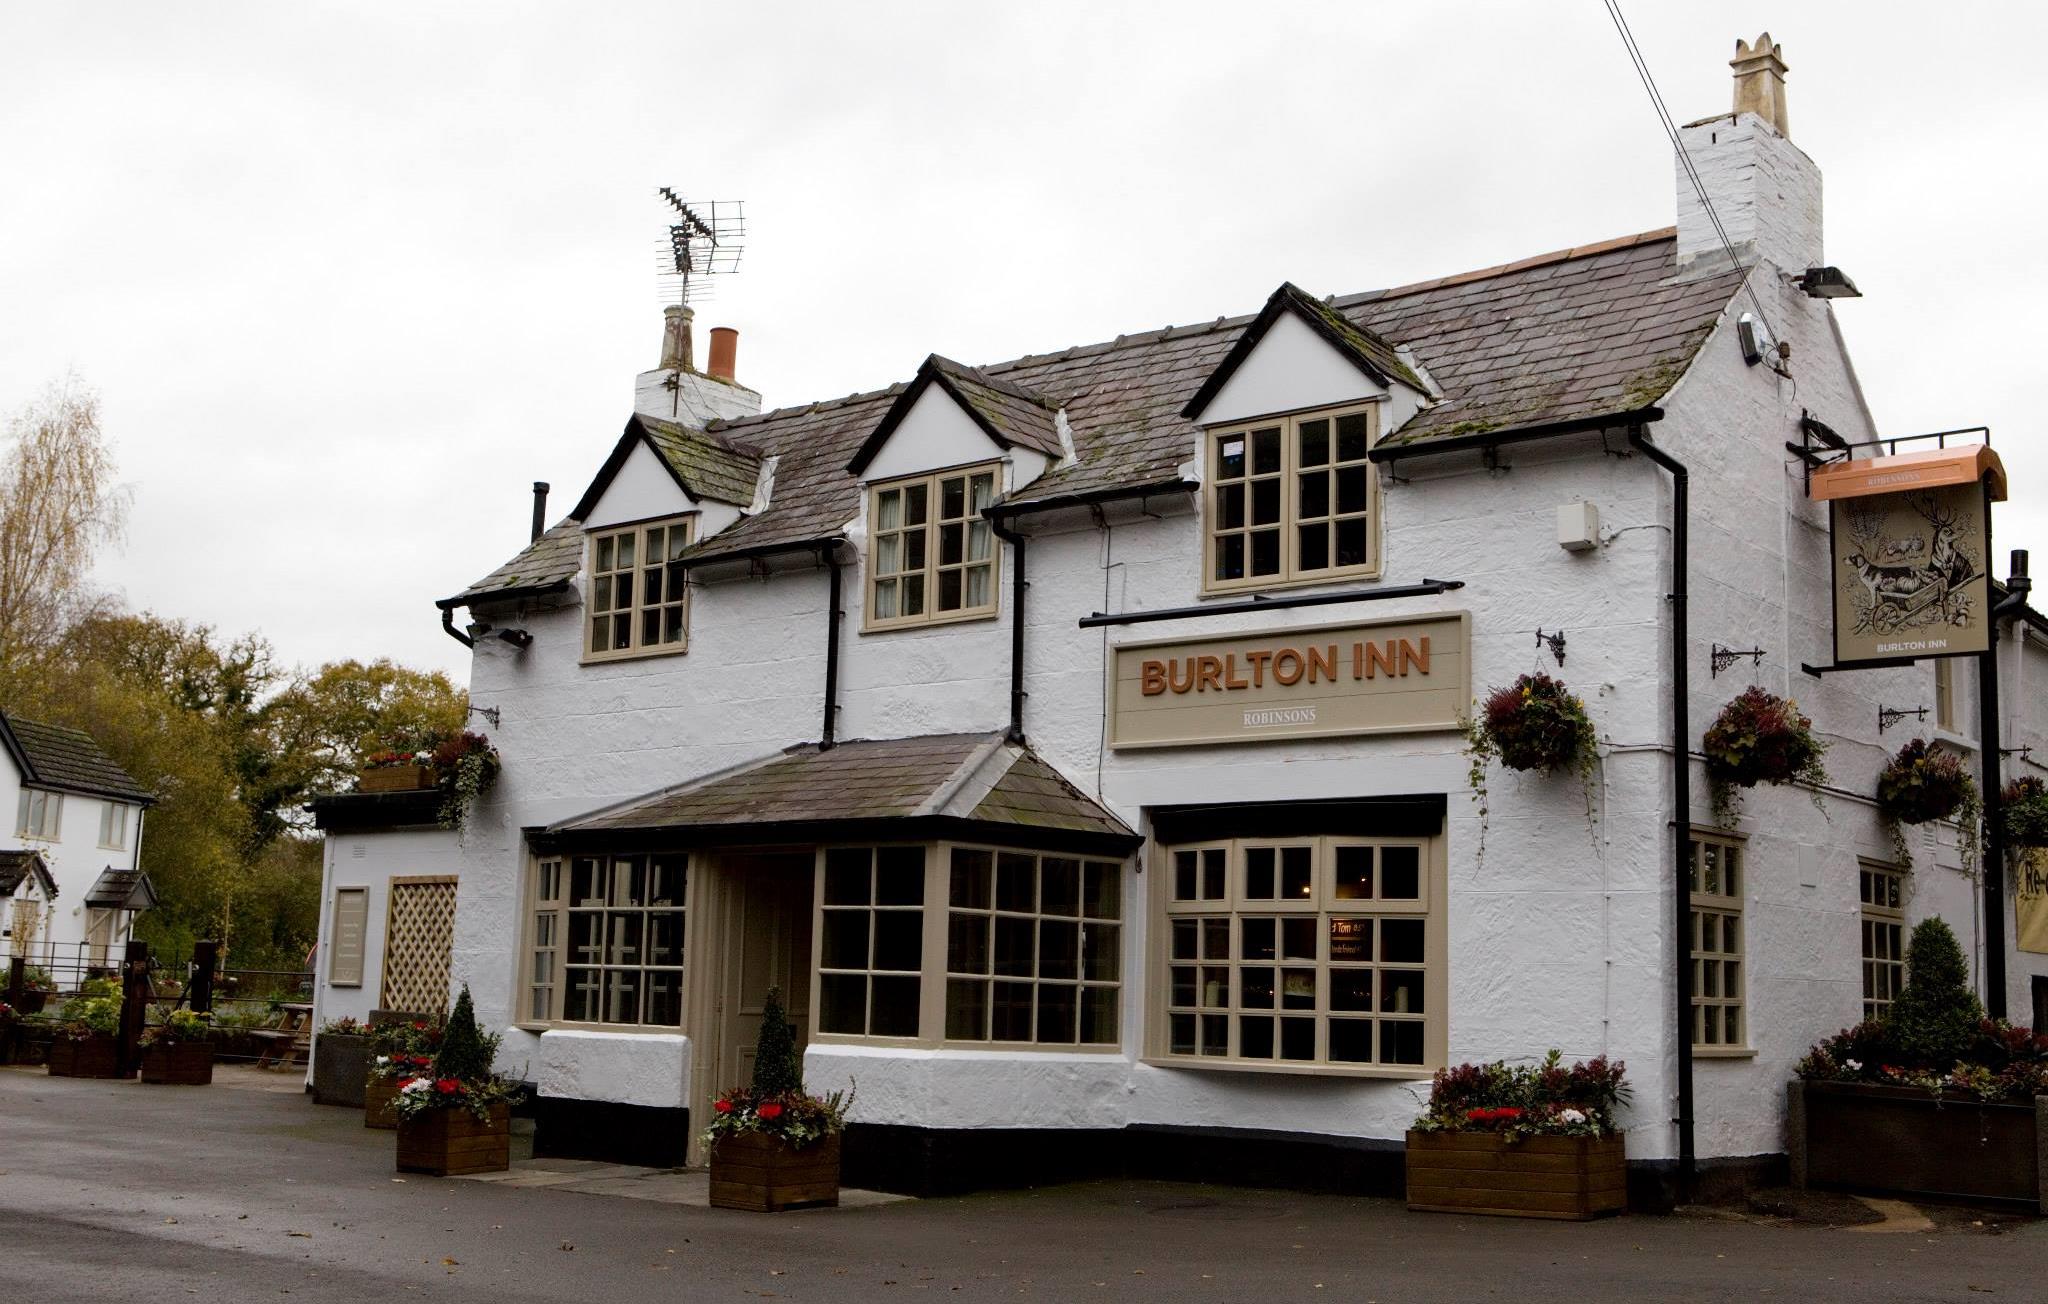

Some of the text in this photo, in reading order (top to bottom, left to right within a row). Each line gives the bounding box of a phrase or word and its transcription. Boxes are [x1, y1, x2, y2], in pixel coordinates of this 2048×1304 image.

[1877, 639, 1947, 653] BURLTON INN
[1141, 637, 1430, 696] BURLTON INN
[1243, 708, 1316, 726] ROBINSONS
[1338, 922, 1351, 934] Tom
